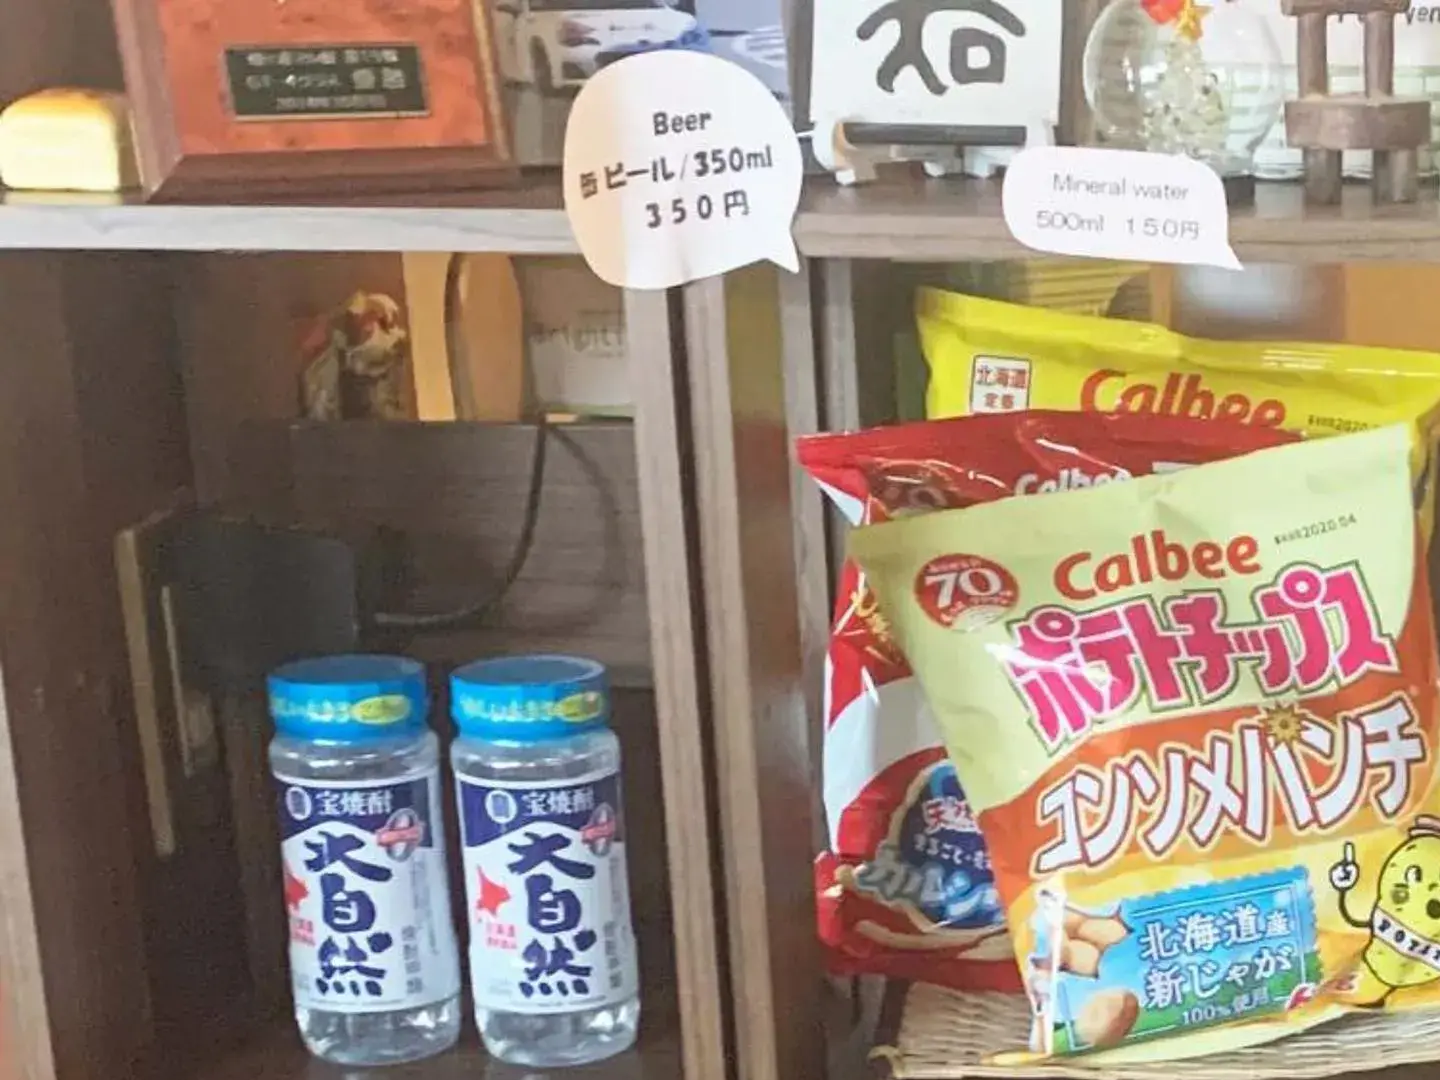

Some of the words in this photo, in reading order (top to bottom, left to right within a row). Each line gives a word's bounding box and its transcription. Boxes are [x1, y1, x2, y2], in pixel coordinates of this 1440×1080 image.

[652, 111, 712, 136] Beer
[1036, 210, 1105, 232] 500ml
[1053, 173, 1126, 196] Mineral
[1132, 182, 1189, 201] water
[924, 566, 1002, 609] 70
[1053, 529, 1263, 601] Calbee
[1008, 562, 1399, 754] ポテトチップス
[1033, 697, 1427, 872] コンソメパンチ
[304, 830, 393, 997] 大自然
[507, 831, 597, 998] 大自然
[1143, 943, 1296, 1010] 新じゃが
